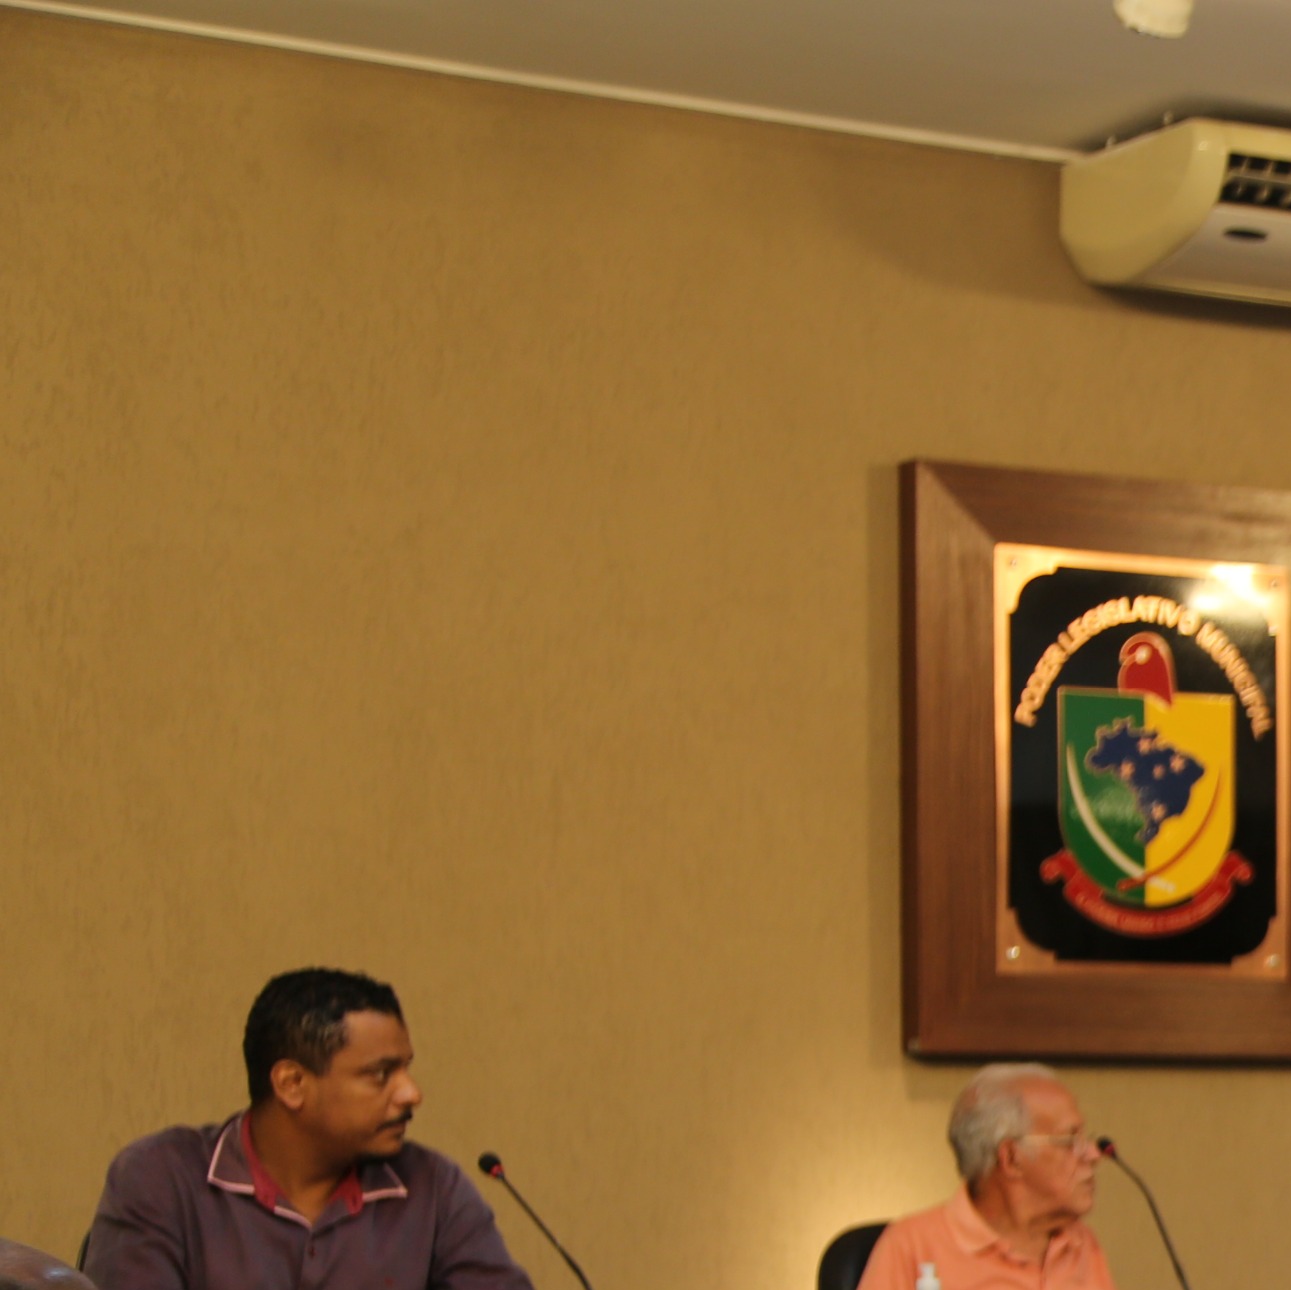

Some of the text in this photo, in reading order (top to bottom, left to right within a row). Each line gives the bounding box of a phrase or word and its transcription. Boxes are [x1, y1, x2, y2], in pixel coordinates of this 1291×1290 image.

[1013, 594, 1274, 742] PODER LEGISLATIVO MUNICIPAL
